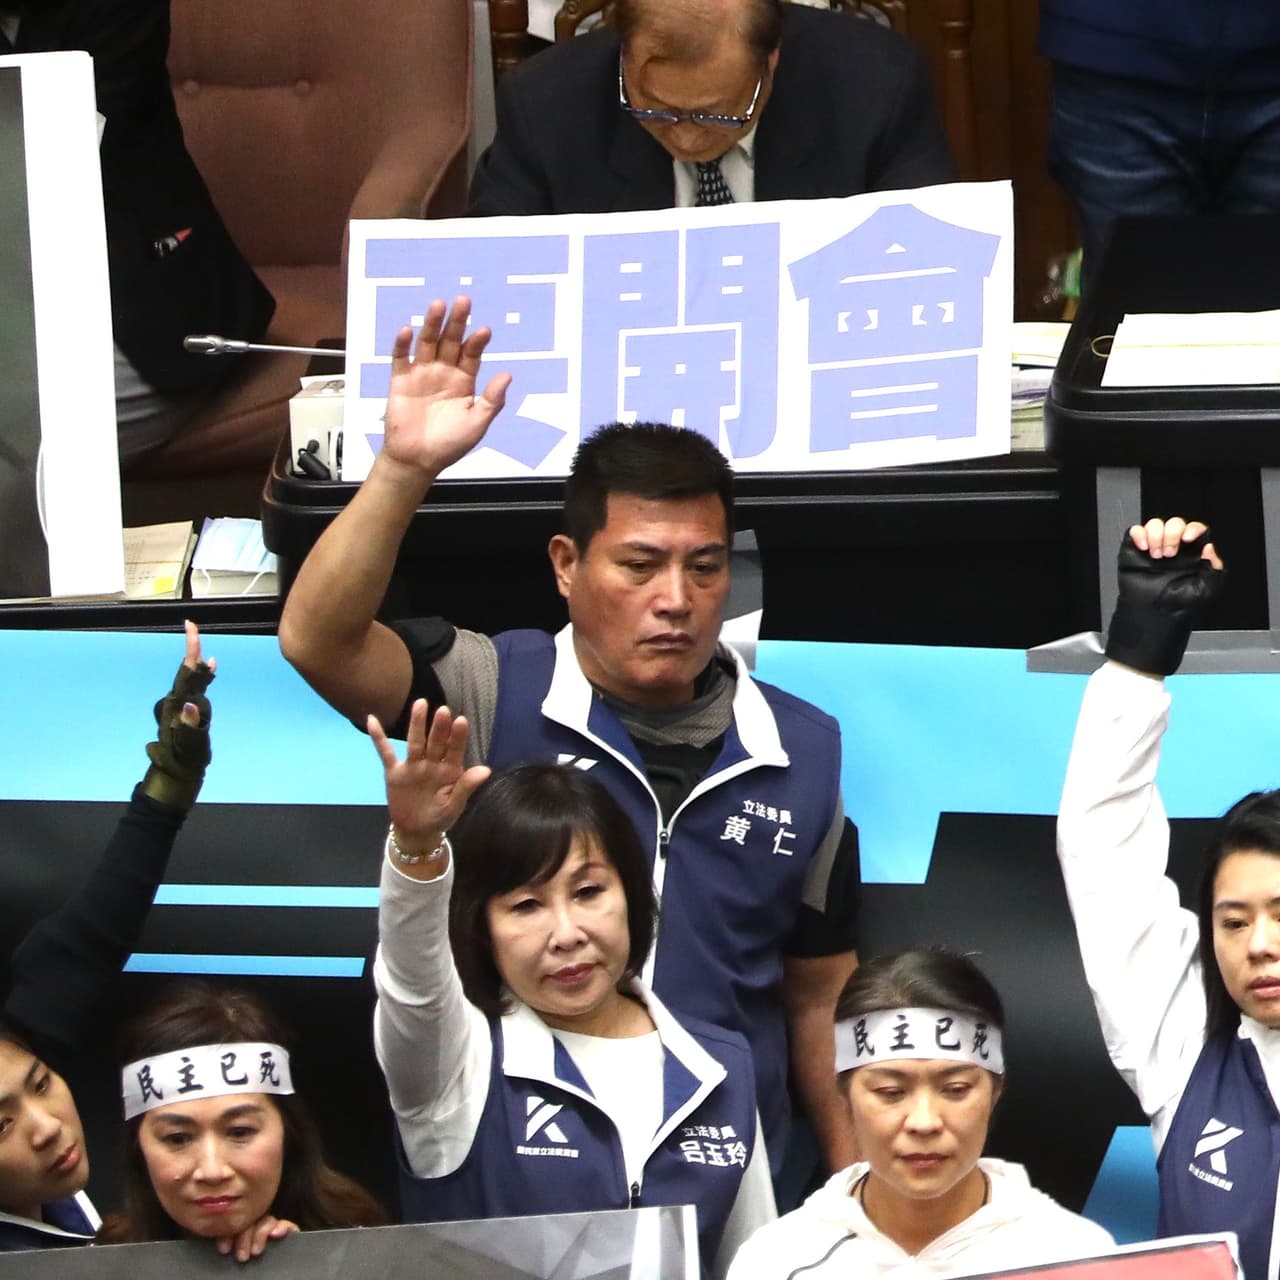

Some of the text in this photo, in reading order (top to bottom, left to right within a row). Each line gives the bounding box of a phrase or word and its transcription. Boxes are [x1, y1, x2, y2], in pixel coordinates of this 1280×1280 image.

[742, 799, 792, 825] 立法委員
[853, 1014, 990, 1061] 民主已死
[136, 1050, 281, 1104] 民主已死
[682, 1125, 737, 1141] 立法委員
[680, 1140, 748, 1169] 呂玉玲
